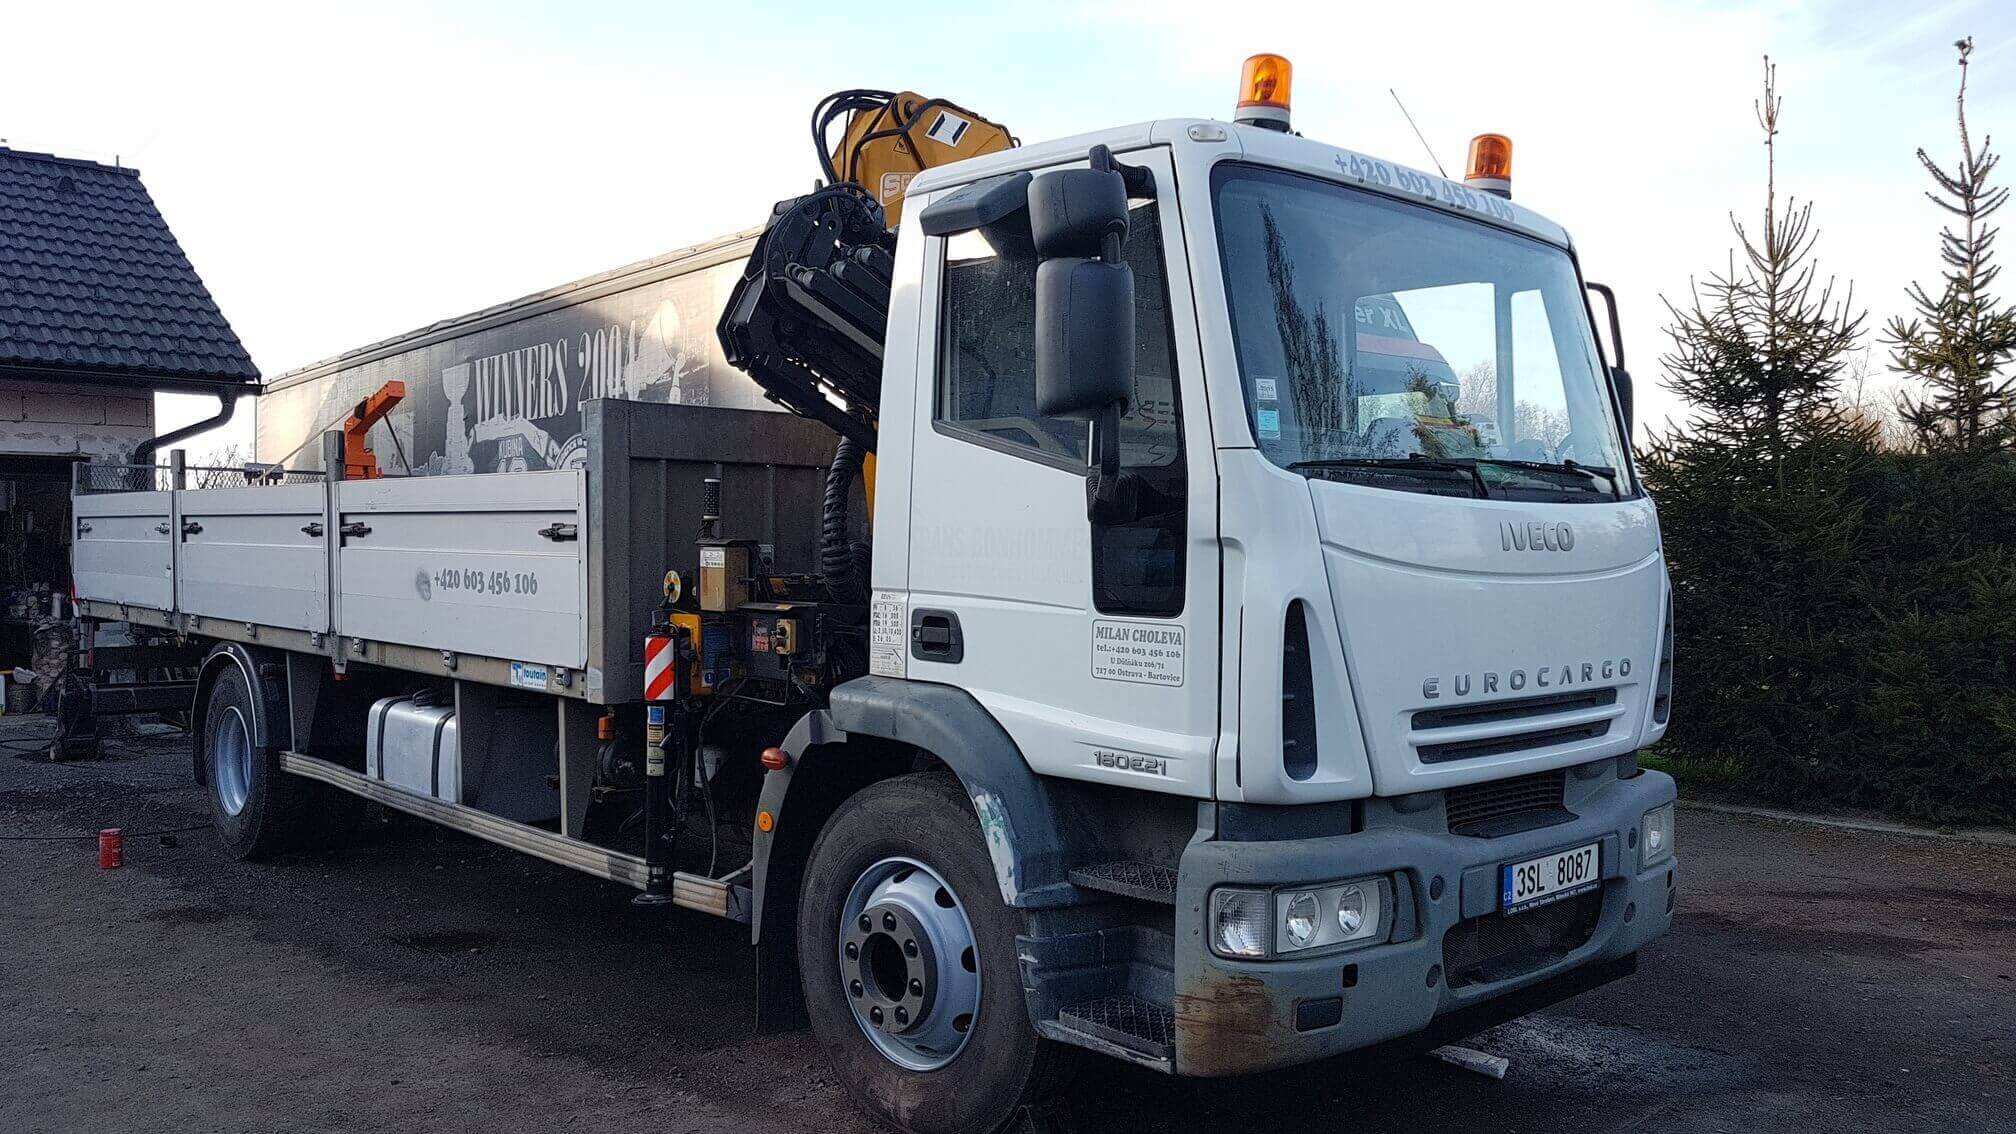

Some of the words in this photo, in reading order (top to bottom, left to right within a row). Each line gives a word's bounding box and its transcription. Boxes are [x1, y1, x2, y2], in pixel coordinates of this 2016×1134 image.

[475, 337, 568, 425] WINNERS
[1499, 521, 1575, 552] IVECO
[434, 567, 461, 591] +420
[463, 568, 485, 594] 603
[488, 570, 511, 596] 456
[514, 571, 538, 596] 106
[1096, 625, 1130, 641] MILAN
[1132, 628, 1182, 646] CHOLEVA
[1131, 646, 1147, 657] 603
[1148, 648, 1164, 658] 456
[1165, 650, 1182, 659] 106
[1422, 657, 1633, 700] EUROCARGO
[1503, 890, 1513, 902] CZ
[1516, 863, 1546, 898] 3SL
[1557, 849, 1592, 886] 8087
